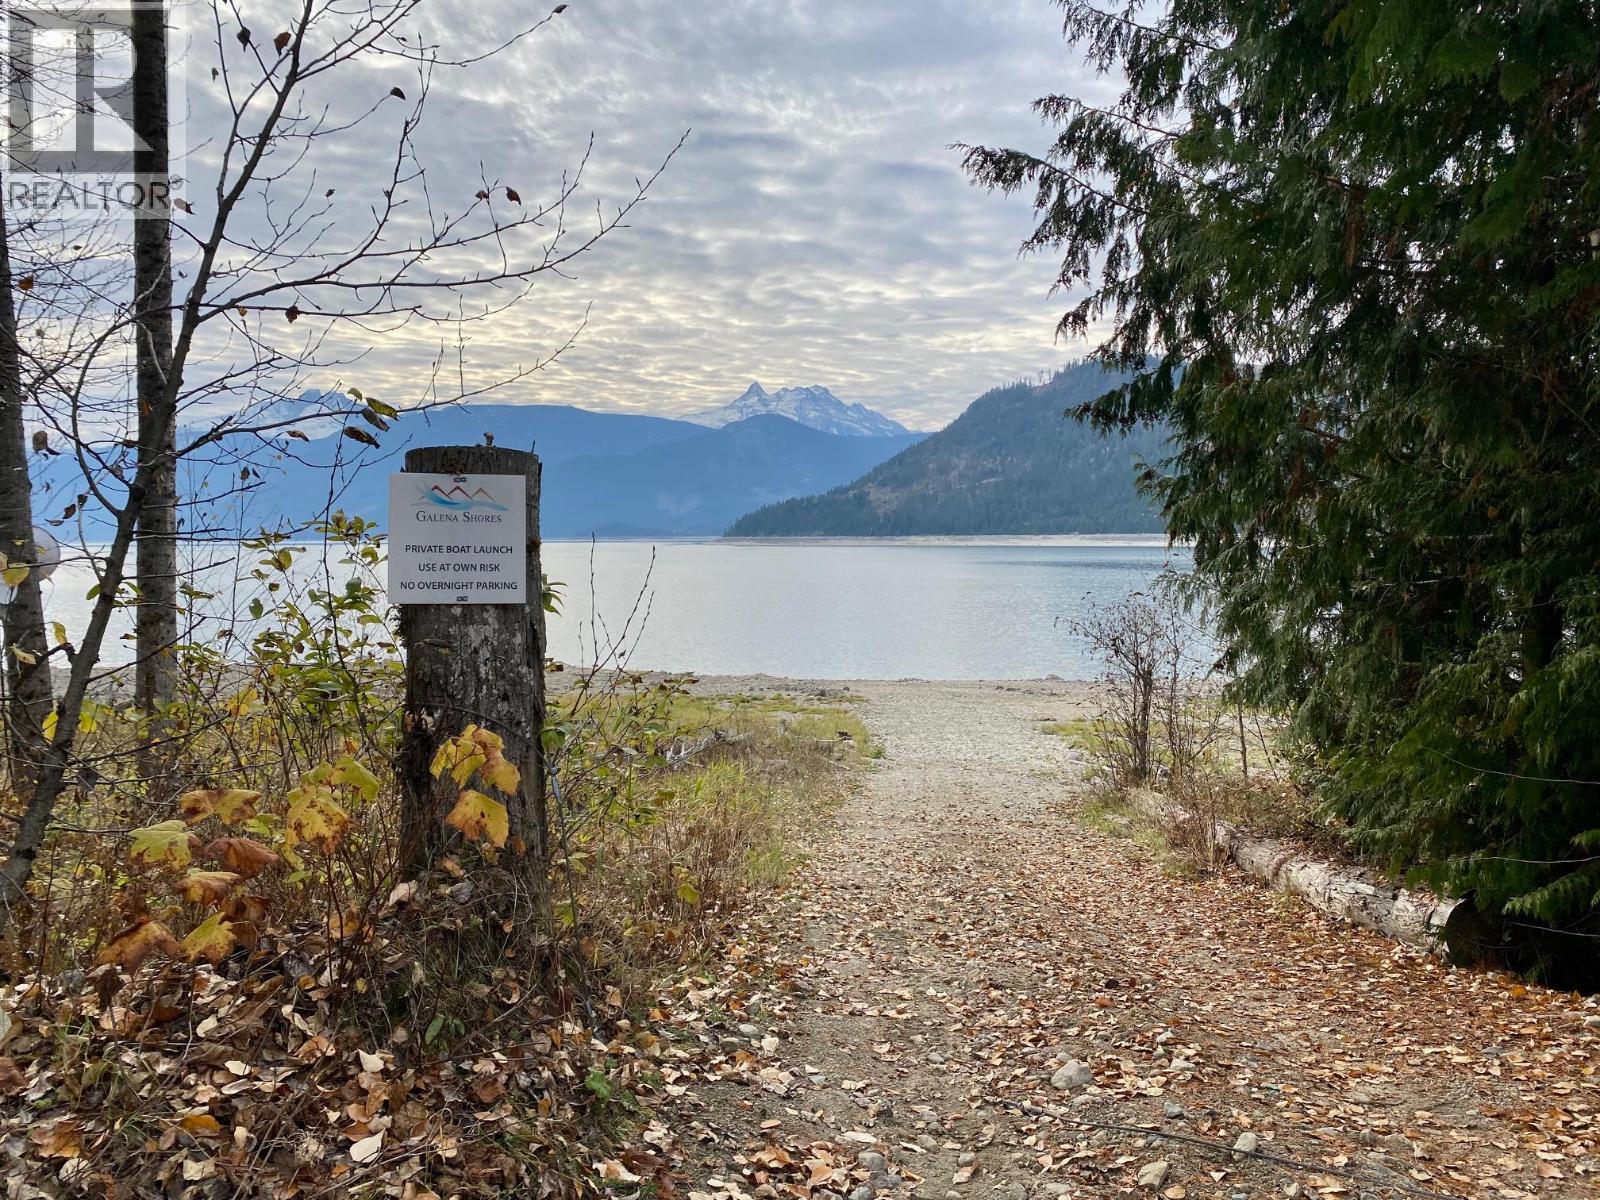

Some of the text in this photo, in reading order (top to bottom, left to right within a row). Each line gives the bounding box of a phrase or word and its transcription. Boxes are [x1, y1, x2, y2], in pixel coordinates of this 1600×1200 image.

[405, 545, 513, 554] PRIVATE BOAT LAUNCH
[418, 563, 500, 572] USE AT OWN RISK
[400, 581, 518, 590] NO OVERNIGHT PARKING
